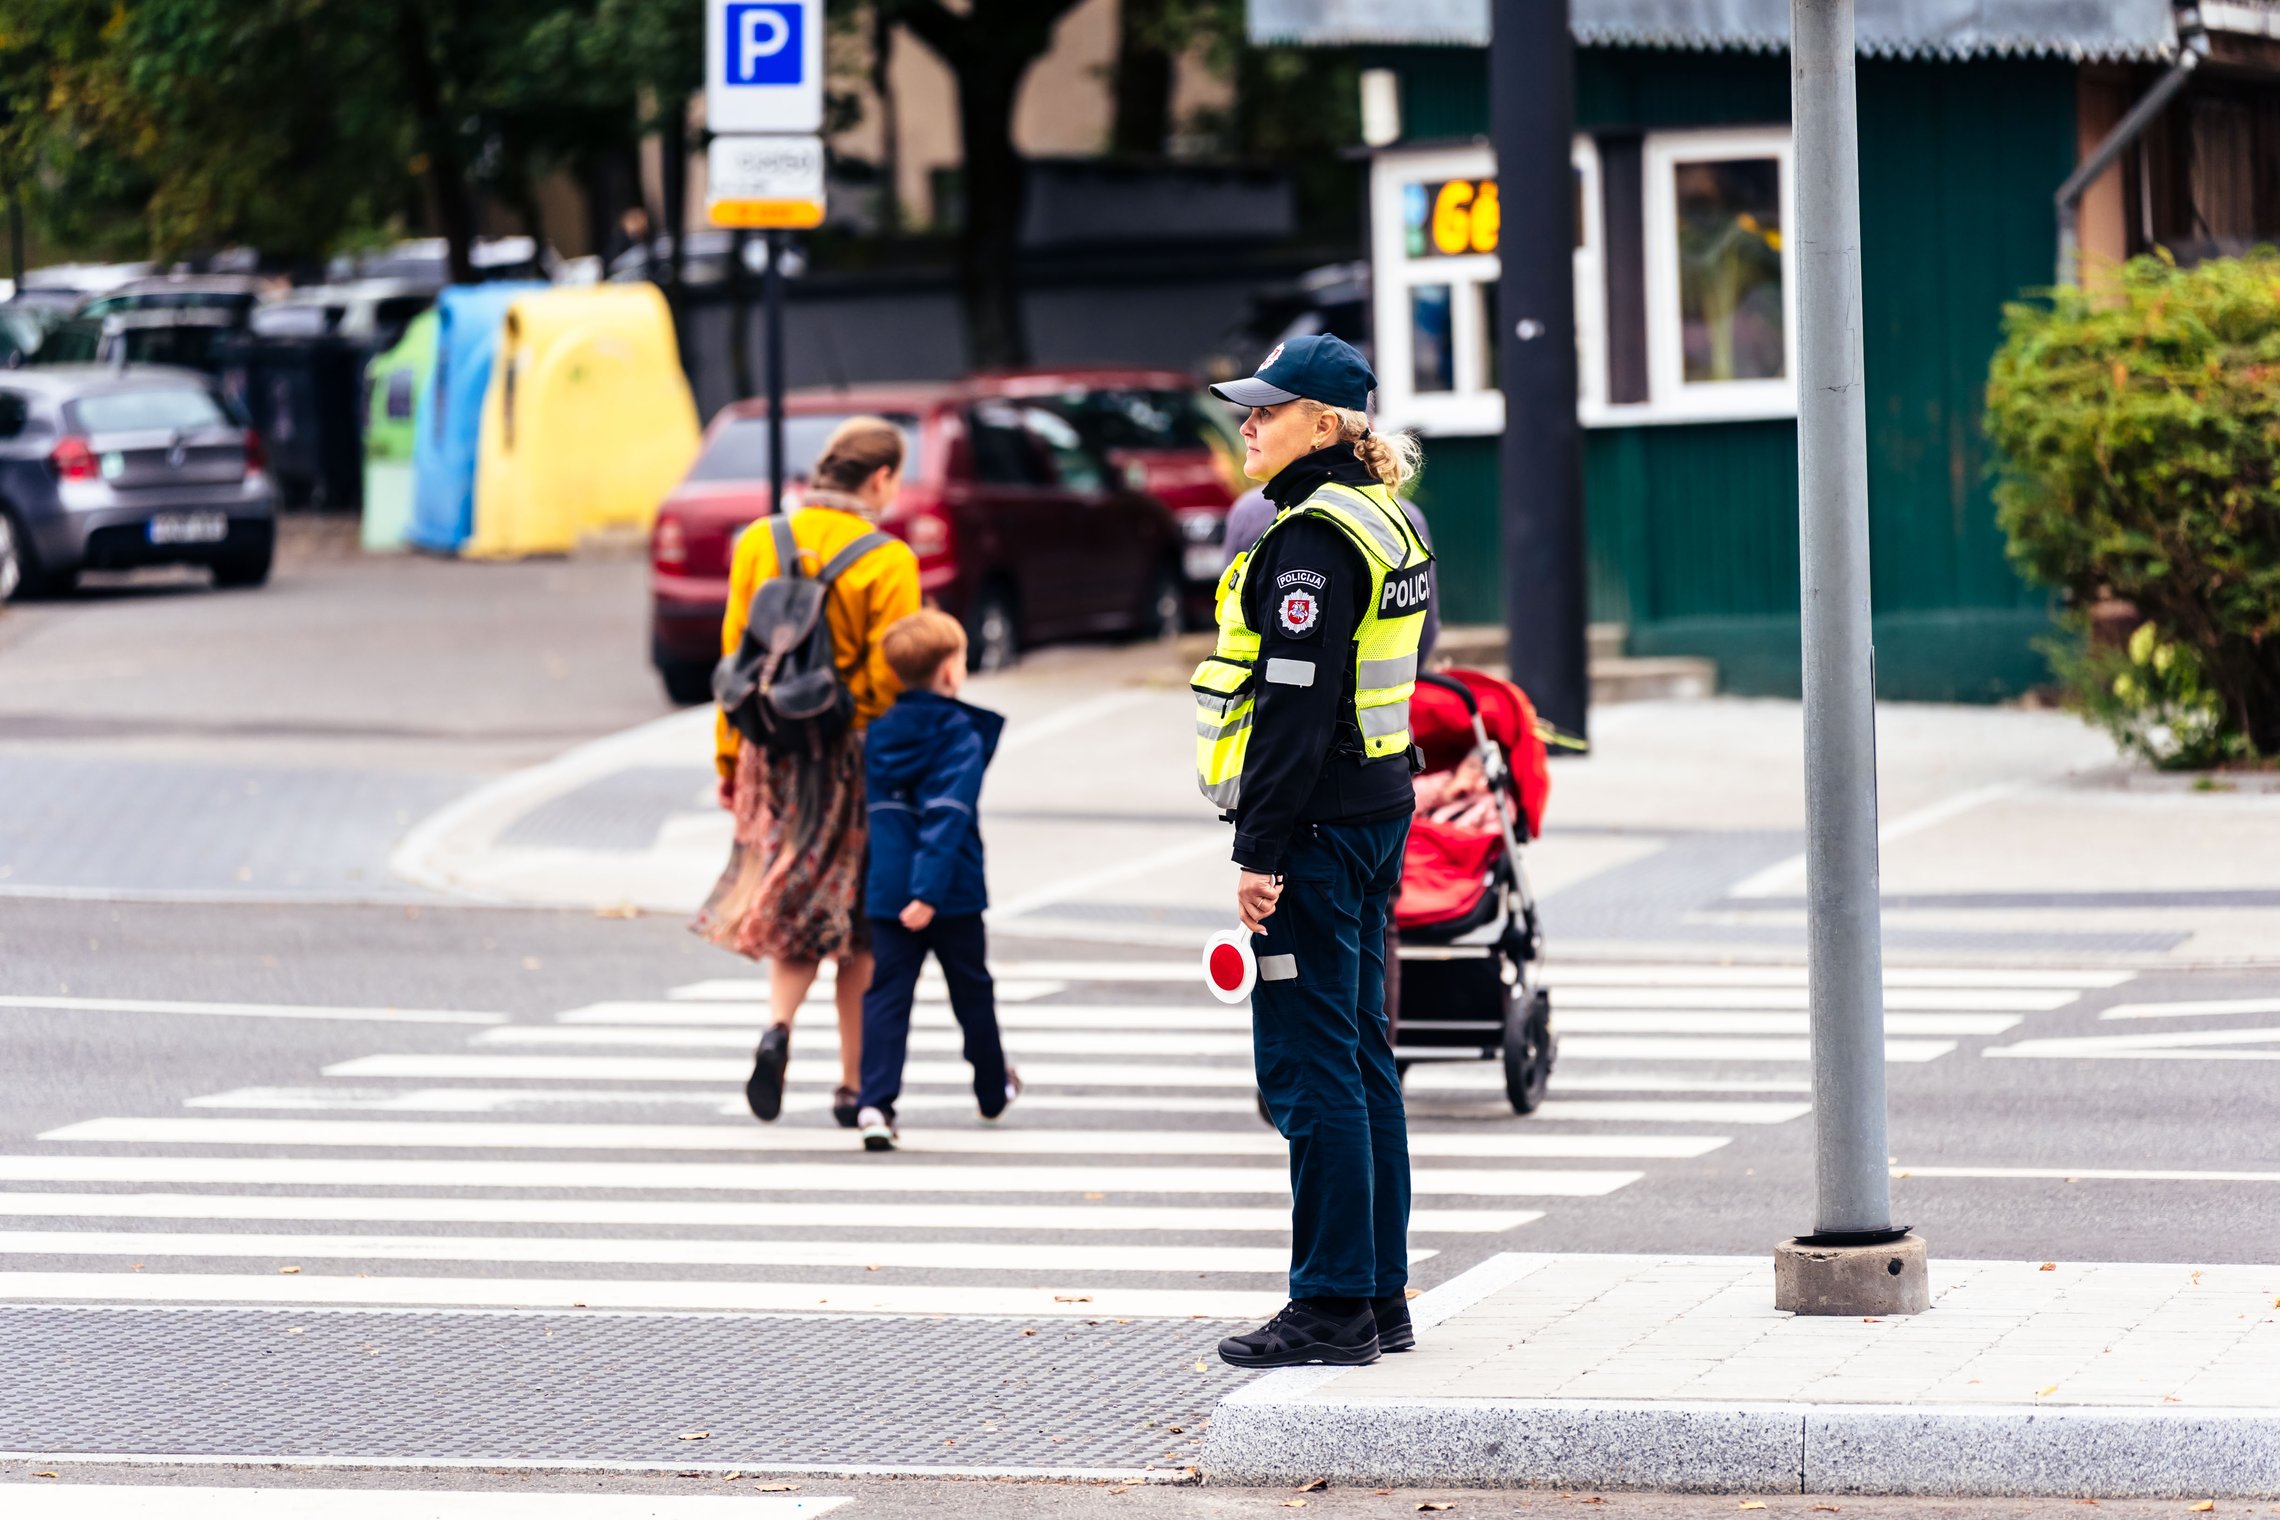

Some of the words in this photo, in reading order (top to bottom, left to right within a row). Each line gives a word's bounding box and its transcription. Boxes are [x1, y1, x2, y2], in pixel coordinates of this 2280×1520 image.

[739, 8, 790, 81] P
[1280, 572, 1321, 586] POLICIJA
[1380, 570, 1430, 610] POLICI
